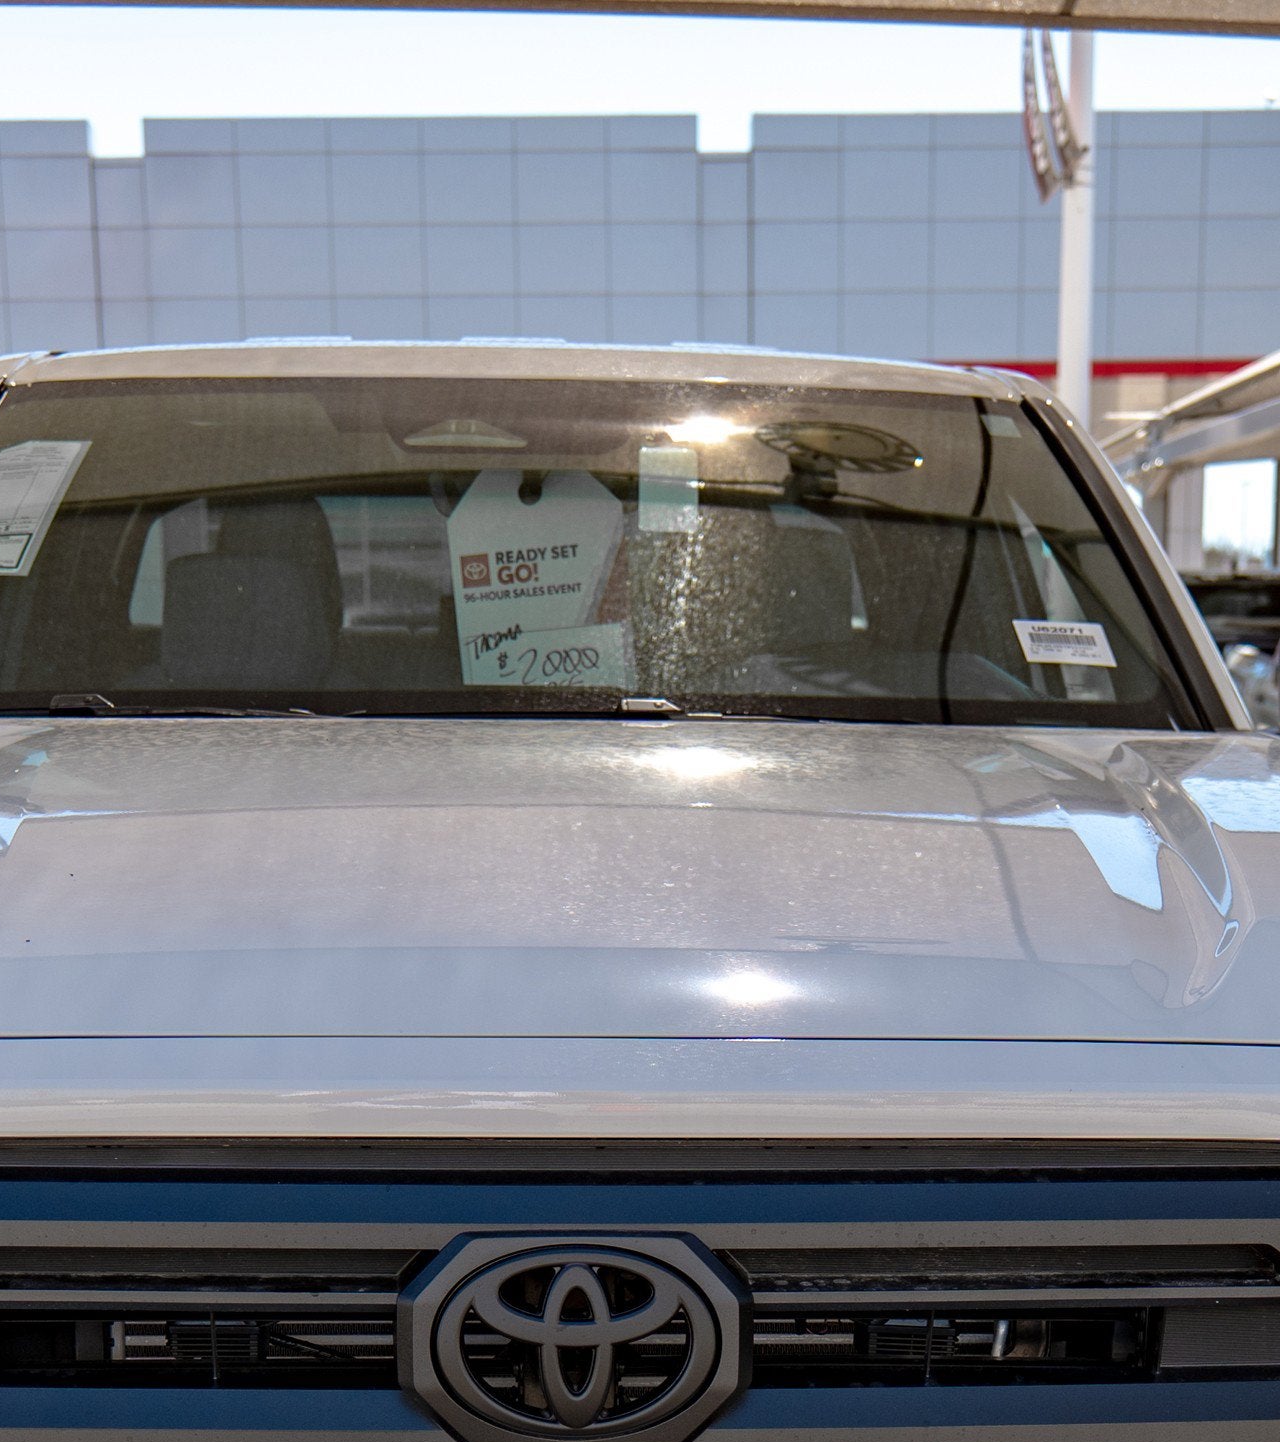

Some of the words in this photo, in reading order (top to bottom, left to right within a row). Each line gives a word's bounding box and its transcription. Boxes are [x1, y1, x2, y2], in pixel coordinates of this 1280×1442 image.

[495, 547, 548, 565] READY
[551, 544, 578, 561] SET
[497, 562, 539, 585] GO!
[464, 590, 512, 604] 96-HOUR
[513, 586, 546, 600] SALES
[547, 582, 582, 596] EVENT
